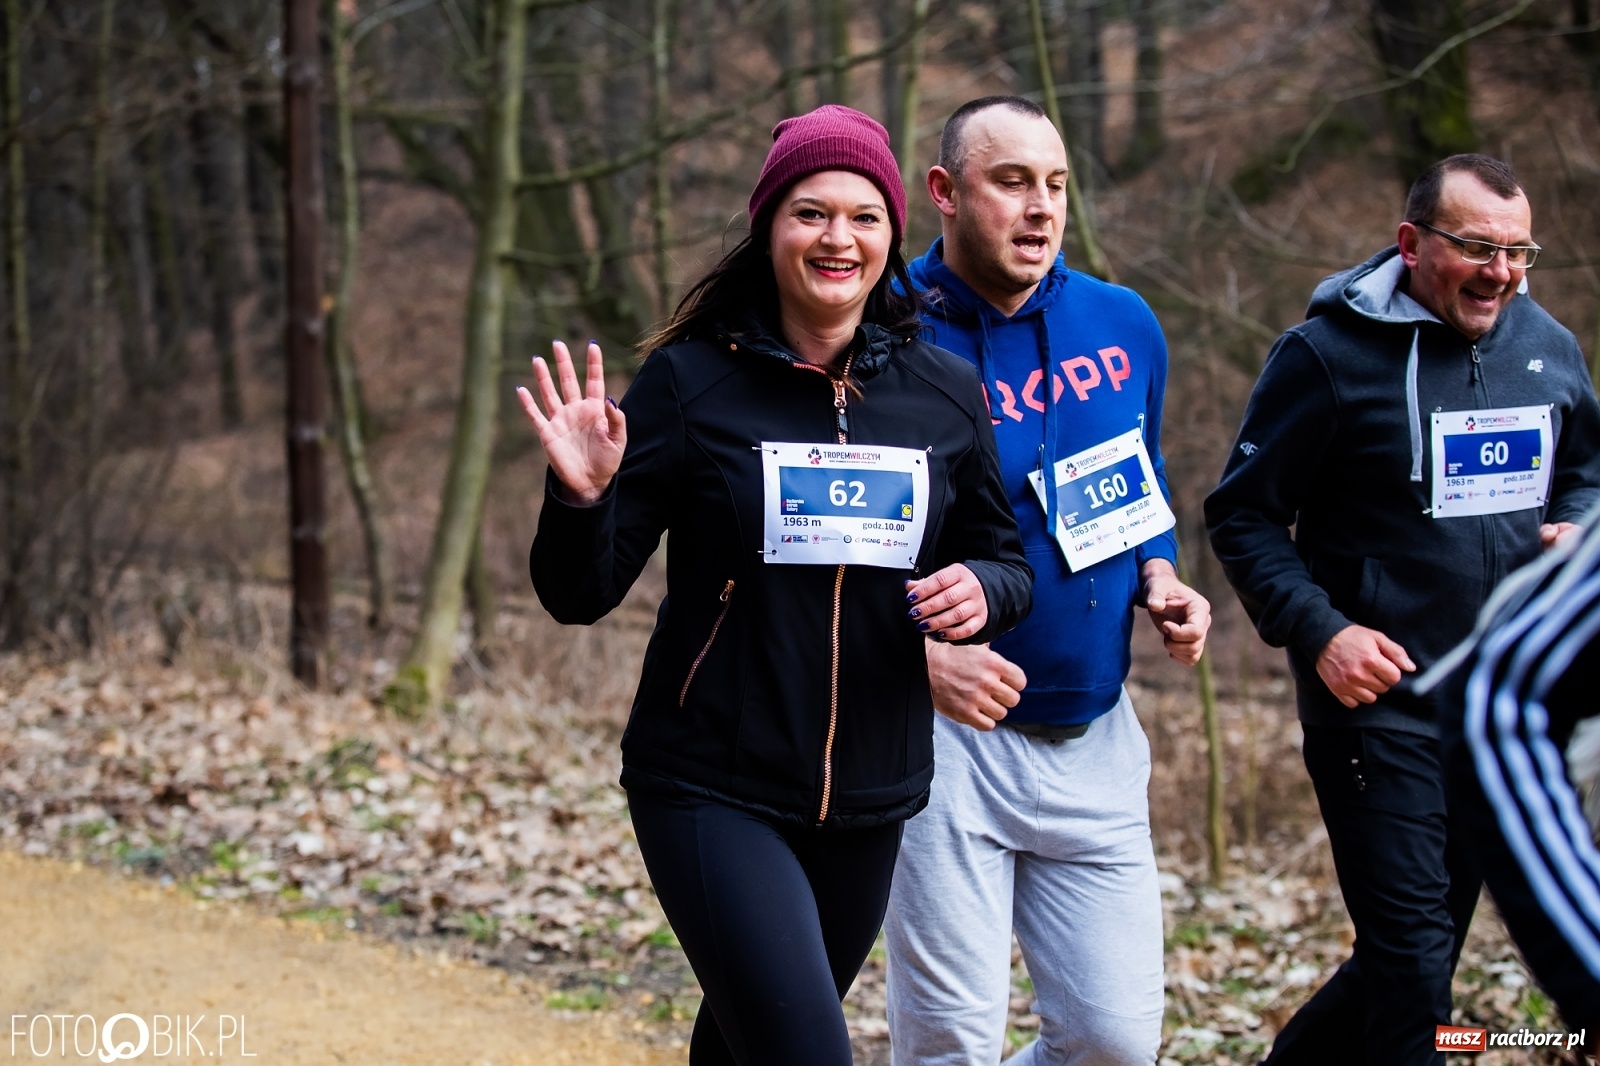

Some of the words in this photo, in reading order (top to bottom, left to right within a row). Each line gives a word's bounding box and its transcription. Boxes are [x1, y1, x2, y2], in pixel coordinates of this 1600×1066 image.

[1527, 359, 1543, 373] 4F
[823, 451, 881, 461] TROPEMWILCZYM
[1240, 442, 1258, 456] 4F
[1480, 441, 1509, 466] 60
[1446, 478, 1465, 487] 1963
[829, 480, 867, 507] 62
[1084, 473, 1128, 510] 160
[783, 517, 809, 527] 1963
[811, 519, 822, 527] m
[862, 521, 905, 532] godz.10.00
[1069, 526, 1089, 539] 1963
[1090, 522, 1099, 530] m
